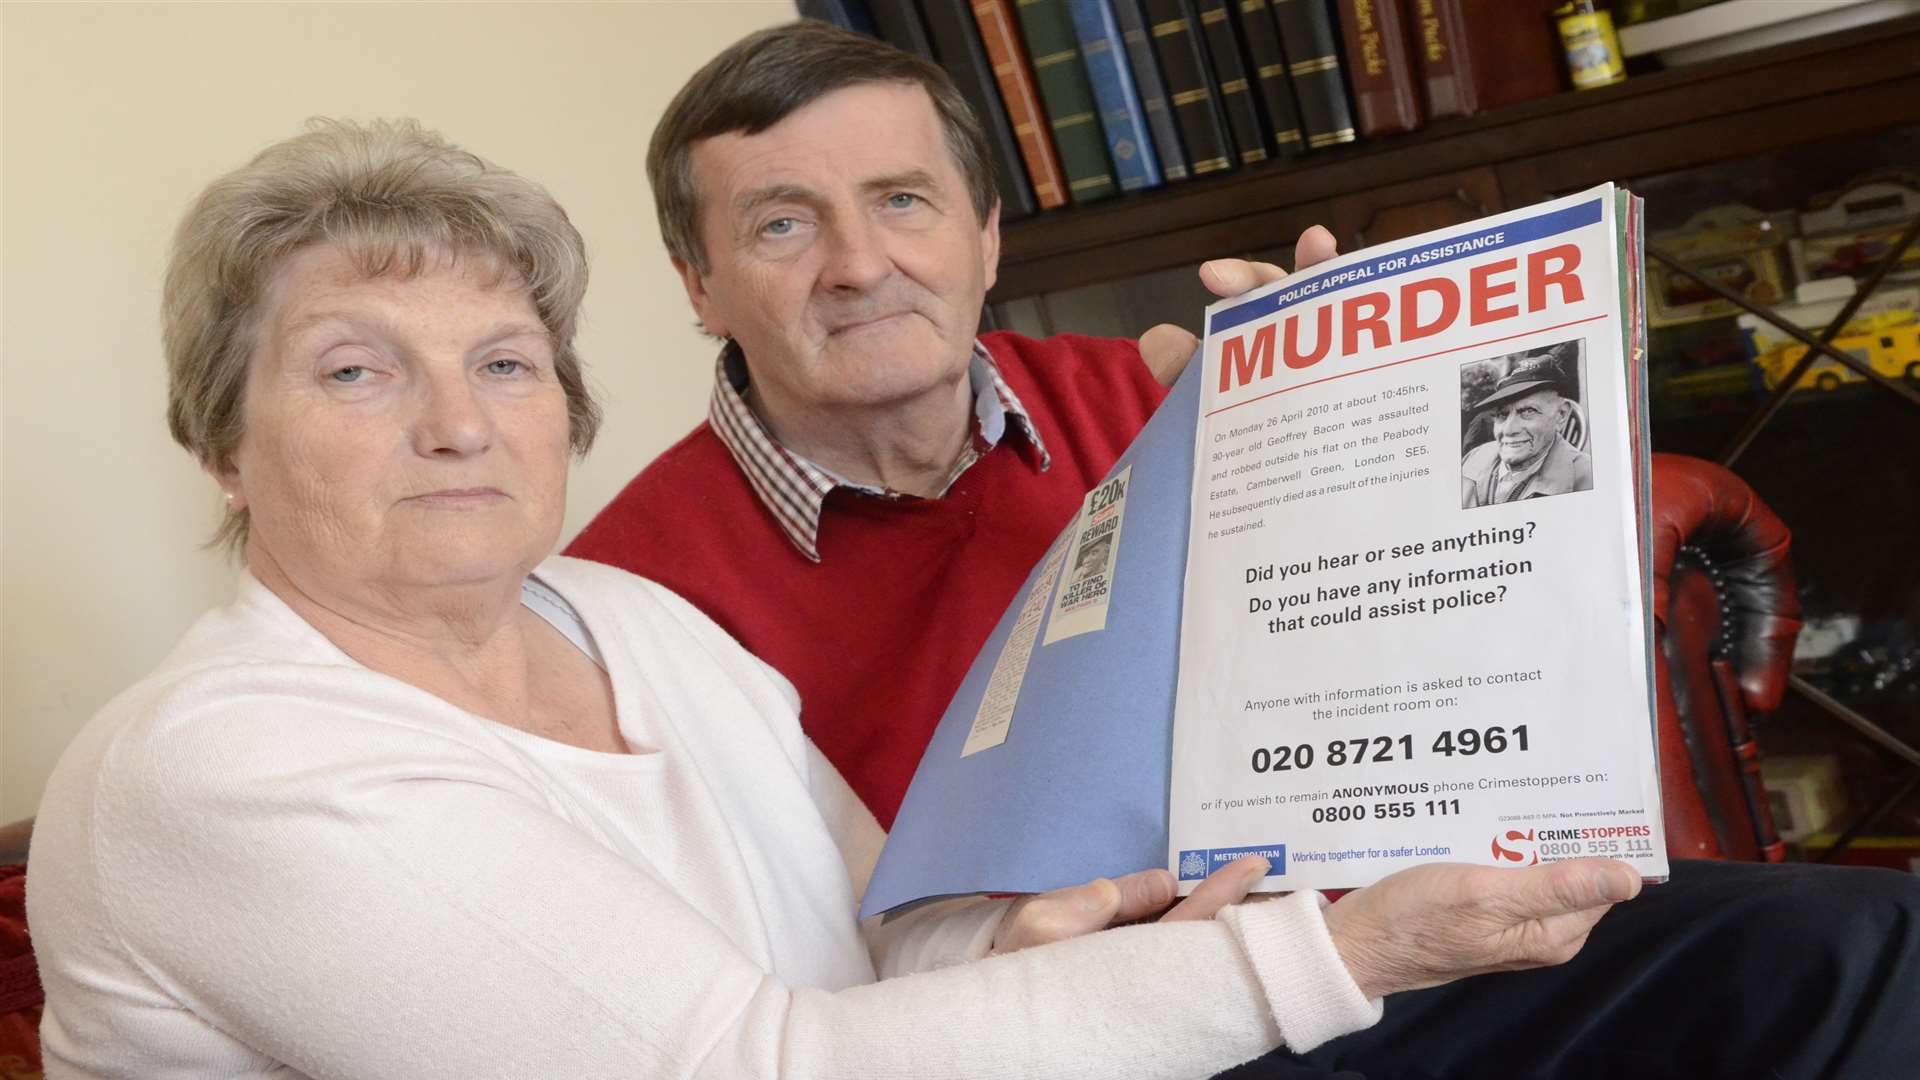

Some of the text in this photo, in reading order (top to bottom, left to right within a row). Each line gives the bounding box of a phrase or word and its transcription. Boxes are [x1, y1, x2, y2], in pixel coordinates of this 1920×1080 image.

[1278, 232, 1505, 305] POLICE APPEAL FOR ASSISTANCE
[1219, 243, 1585, 393] MURDER
[1212, 403, 1429, 462] 90-year old Geoffrey Bacon was assaulted
[1214, 433, 1226, 443] On
[1230, 422, 1263, 438] Monday
[1267, 417, 1278, 427] 26
[1280, 411, 1303, 425] April
[1307, 405, 1329, 417] 2010
[1333, 402, 1343, 412] at
[1347, 394, 1377, 408] about
[1211, 424, 1429, 481] and robbed outside his flat on the Peabody
[1209, 511, 1220, 519] He
[1220, 496, 1281, 517] subsequently
[1283, 490, 1304, 502] died
[1306, 489, 1317, 498] as
[1327, 481, 1356, 494] result
[1358, 478, 1368, 488] of
[1370, 475, 1387, 485] the
[1389, 466, 1429, 483] injuries
[1210, 487, 1238, 500] Estate,
[1246, 471, 1301, 491] Camberwell
[1310, 464, 1344, 476] Green,
[1354, 453, 1395, 467] London
[1081, 515, 1119, 541] REWARD
[1208, 520, 1265, 539] he sustained.
[1246, 522, 1537, 584] Did you hear or see anything?
[1061, 596, 1080, 609] WAR
[1081, 588, 1107, 601] HERO
[1063, 580, 1107, 601] KILLER OF
[1070, 575, 1103, 591] TO FIND
[1250, 560, 1532, 613] Do you have any information
[1268, 585, 1507, 634] that could assist police?
[1244, 669, 1542, 713] Anyone with information is asked to contact
[1312, 696, 1458, 720] the incident room on:
[1252, 724, 1530, 774] 020 8721 4961
[1201, 772, 1608, 811] or if you wish to remain ANONYMOUS phone Crimestoppers on:
[1312, 799, 1461, 824] 0800 555 111
[1538, 825, 1650, 841] CRIMESTOPPERS
[1575, 809, 1616, 818] Protectively
[1292, 845, 1451, 864] Working together for a safer London
[1540, 839, 1652, 856] 0800 555 111
